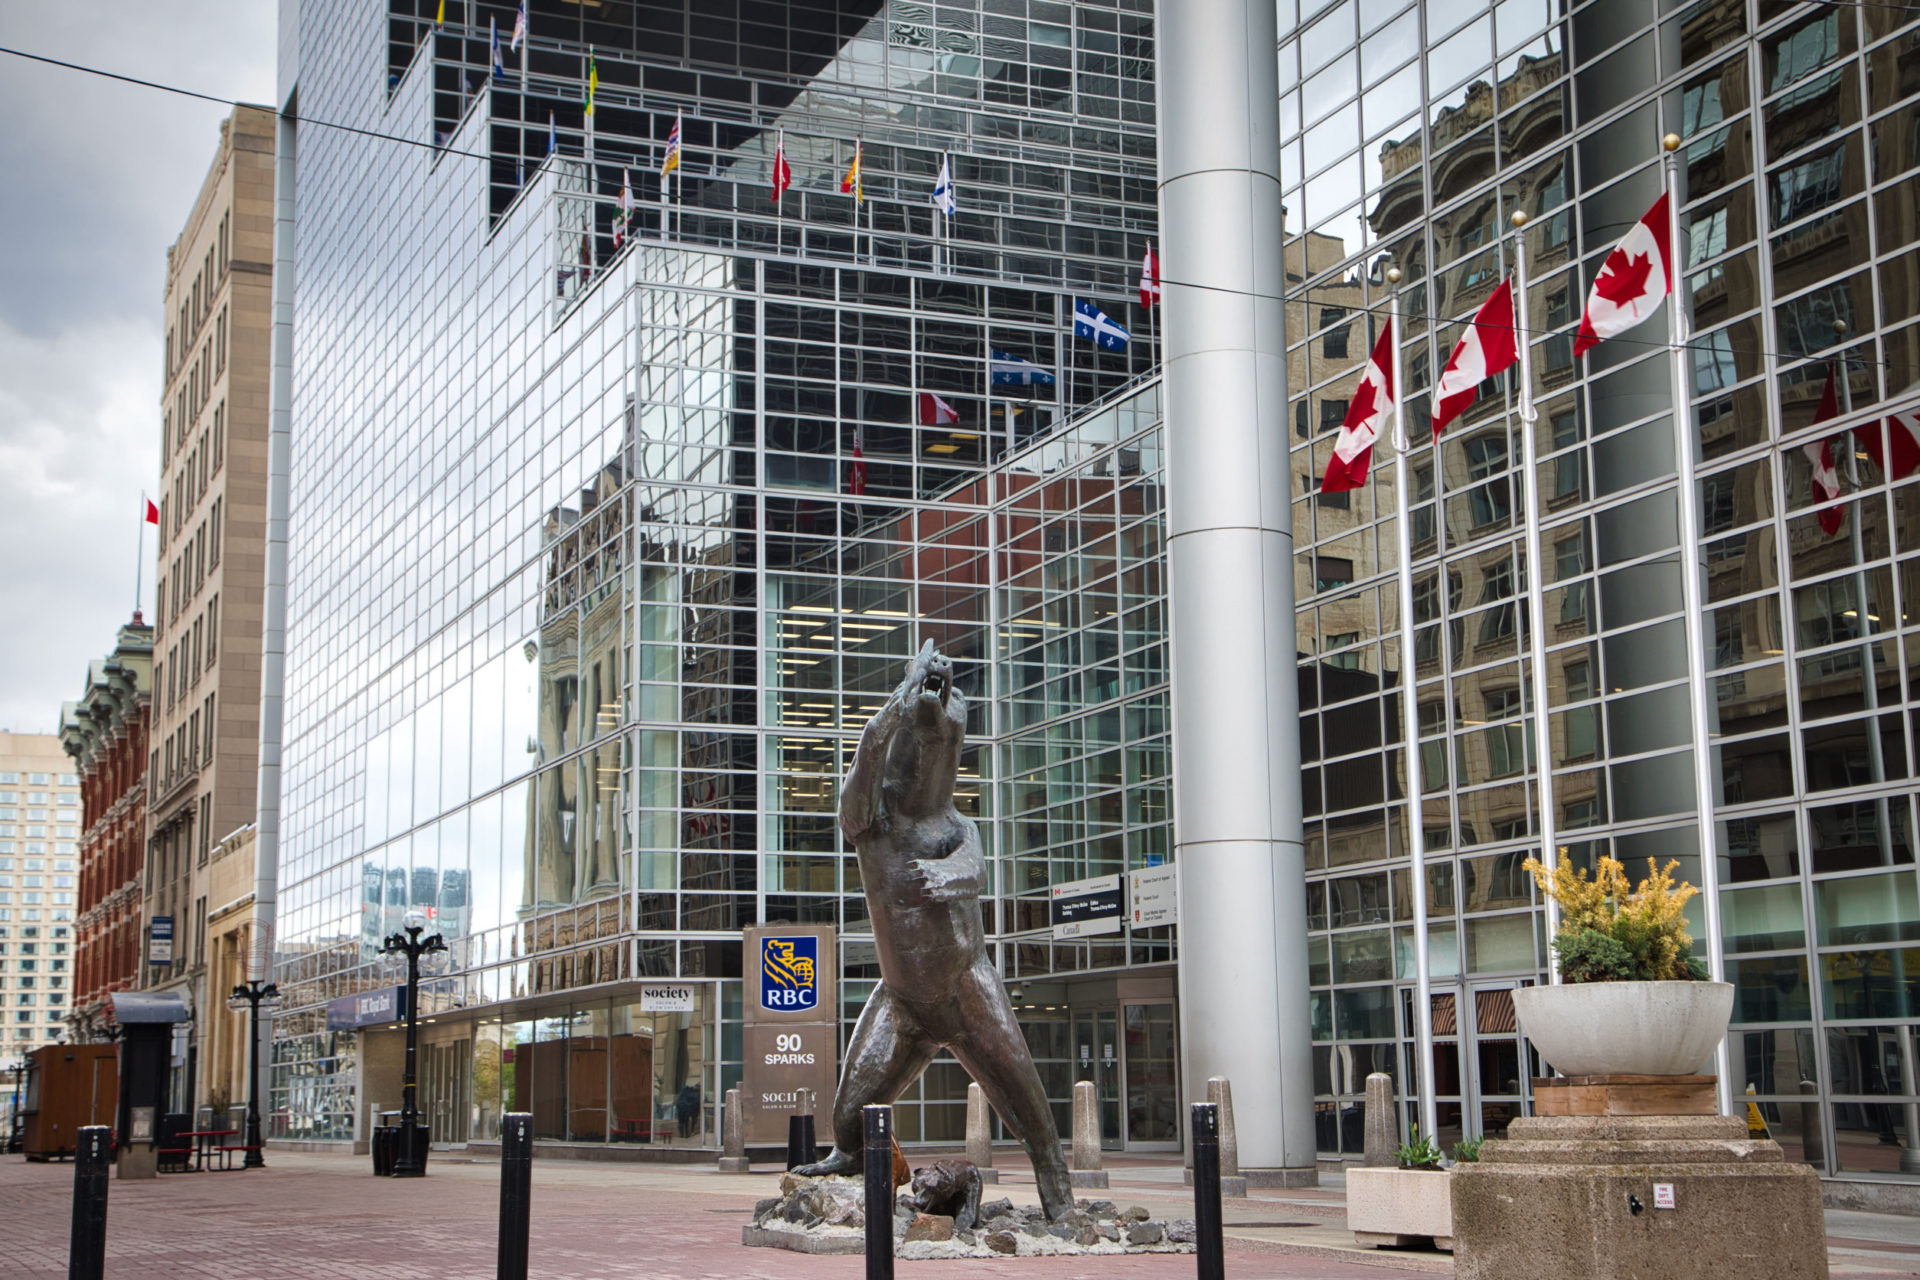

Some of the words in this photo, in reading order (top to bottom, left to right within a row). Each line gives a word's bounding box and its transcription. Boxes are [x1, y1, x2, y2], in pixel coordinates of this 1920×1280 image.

[1062, 924, 1080, 936] Canada
[644, 986, 690, 1002] society
[767, 989, 812, 1006] RBC
[776, 1033, 802, 1052] 90
[764, 1053, 816, 1065] SPARKS
[762, 1092, 817, 1102] SOCIY
